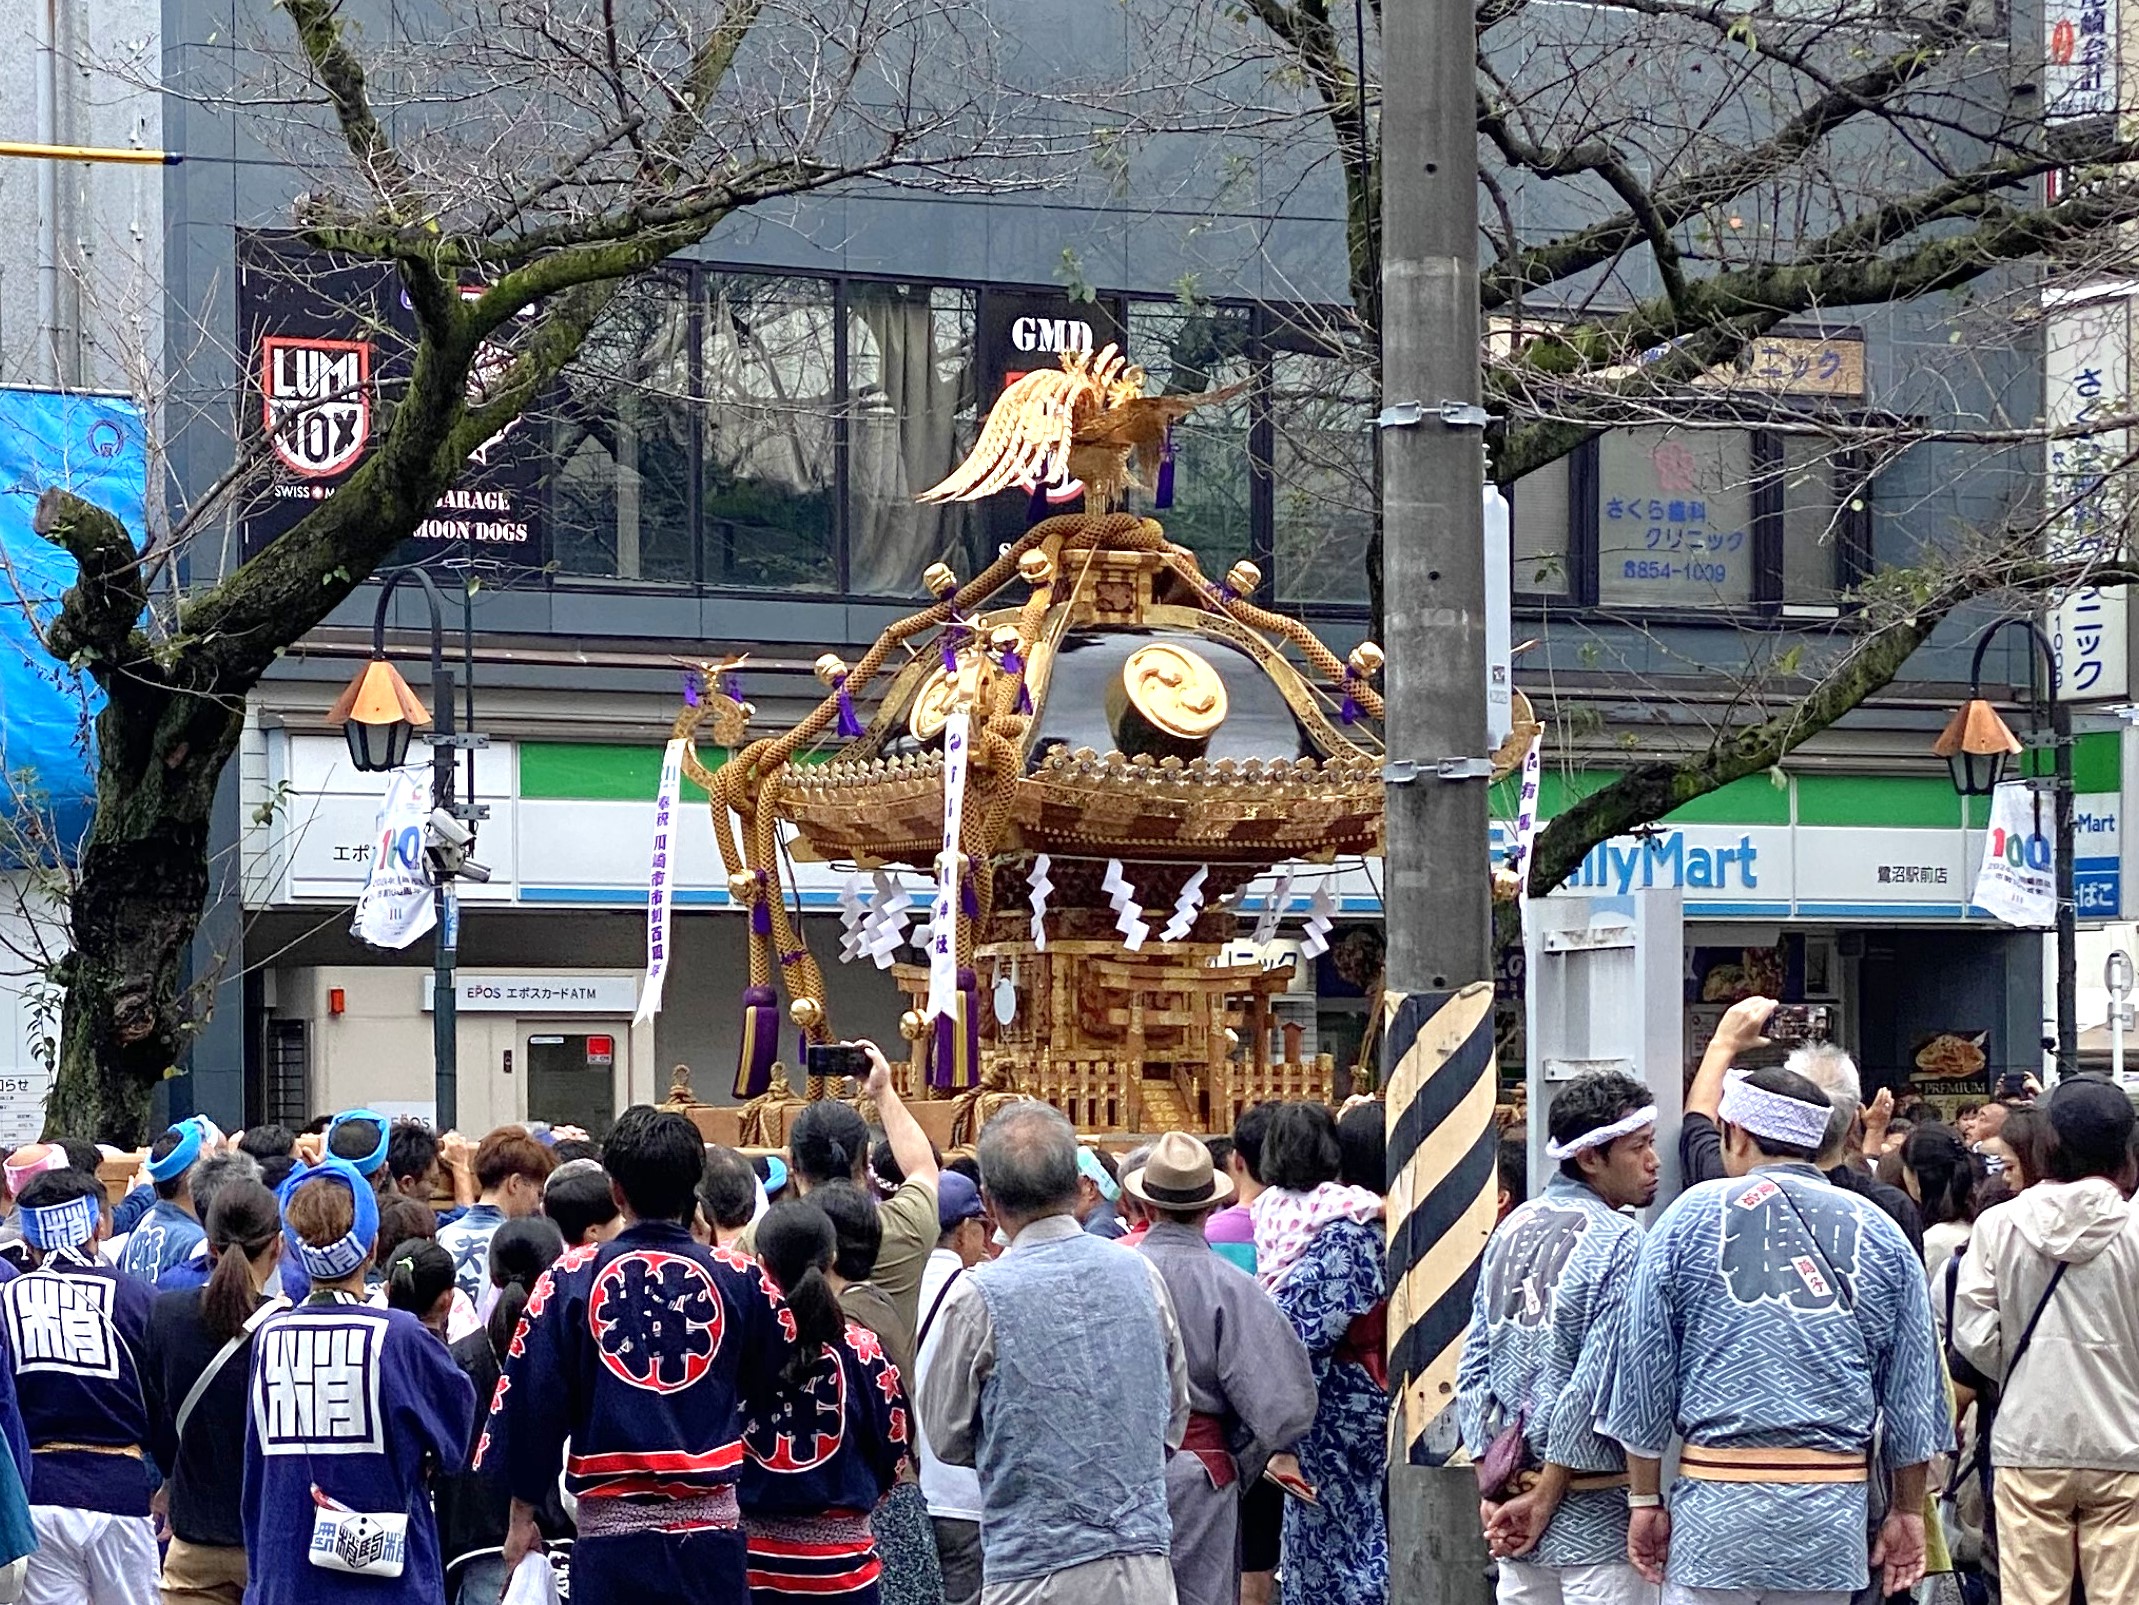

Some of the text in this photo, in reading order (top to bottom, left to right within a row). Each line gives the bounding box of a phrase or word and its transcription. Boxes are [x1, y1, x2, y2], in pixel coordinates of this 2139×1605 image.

[1011, 316, 1094, 353] GMD
[273, 348, 359, 400] LUMI
[273, 485, 310, 499] SWISS
[433, 490, 511, 510] ARAGE
[1606, 496, 1706, 523] さくら歯科
[476, 522, 528, 542] DOGS
[1646, 527, 1745, 552] クリニック
[1877, 866, 1948, 884] 鷺沼駅前店
[2074, 882, 2114, 908] ばこ
[467, 987, 596, 1000] EPOS エポスカードATM
[1924, 1082, 1986, 1094] PREMIUM
